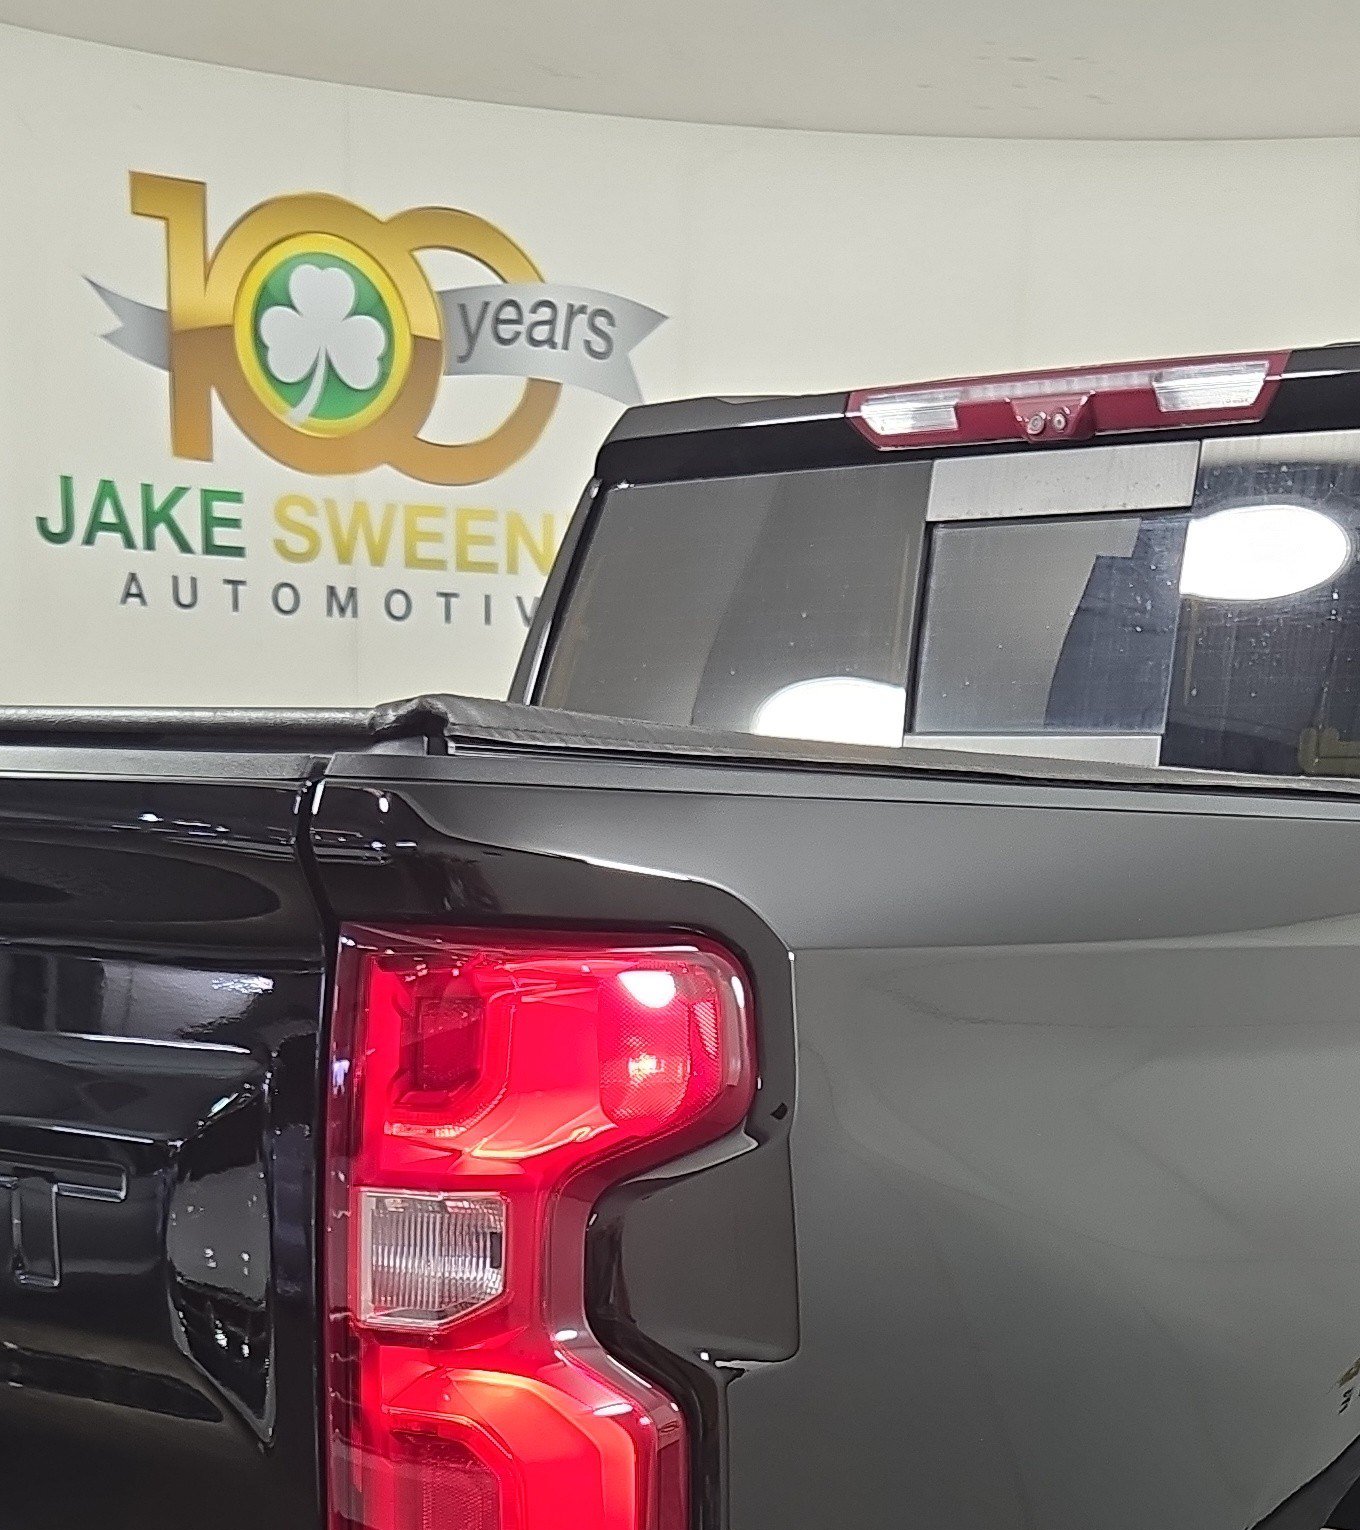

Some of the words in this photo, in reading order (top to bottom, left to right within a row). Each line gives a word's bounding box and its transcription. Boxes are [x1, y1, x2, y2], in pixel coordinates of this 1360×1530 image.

[456, 298, 618, 362] years
[36, 474, 247, 558] JAKE
[272, 492, 556, 577] SWEEN
[120, 571, 540, 628] AUTOMOTIV
